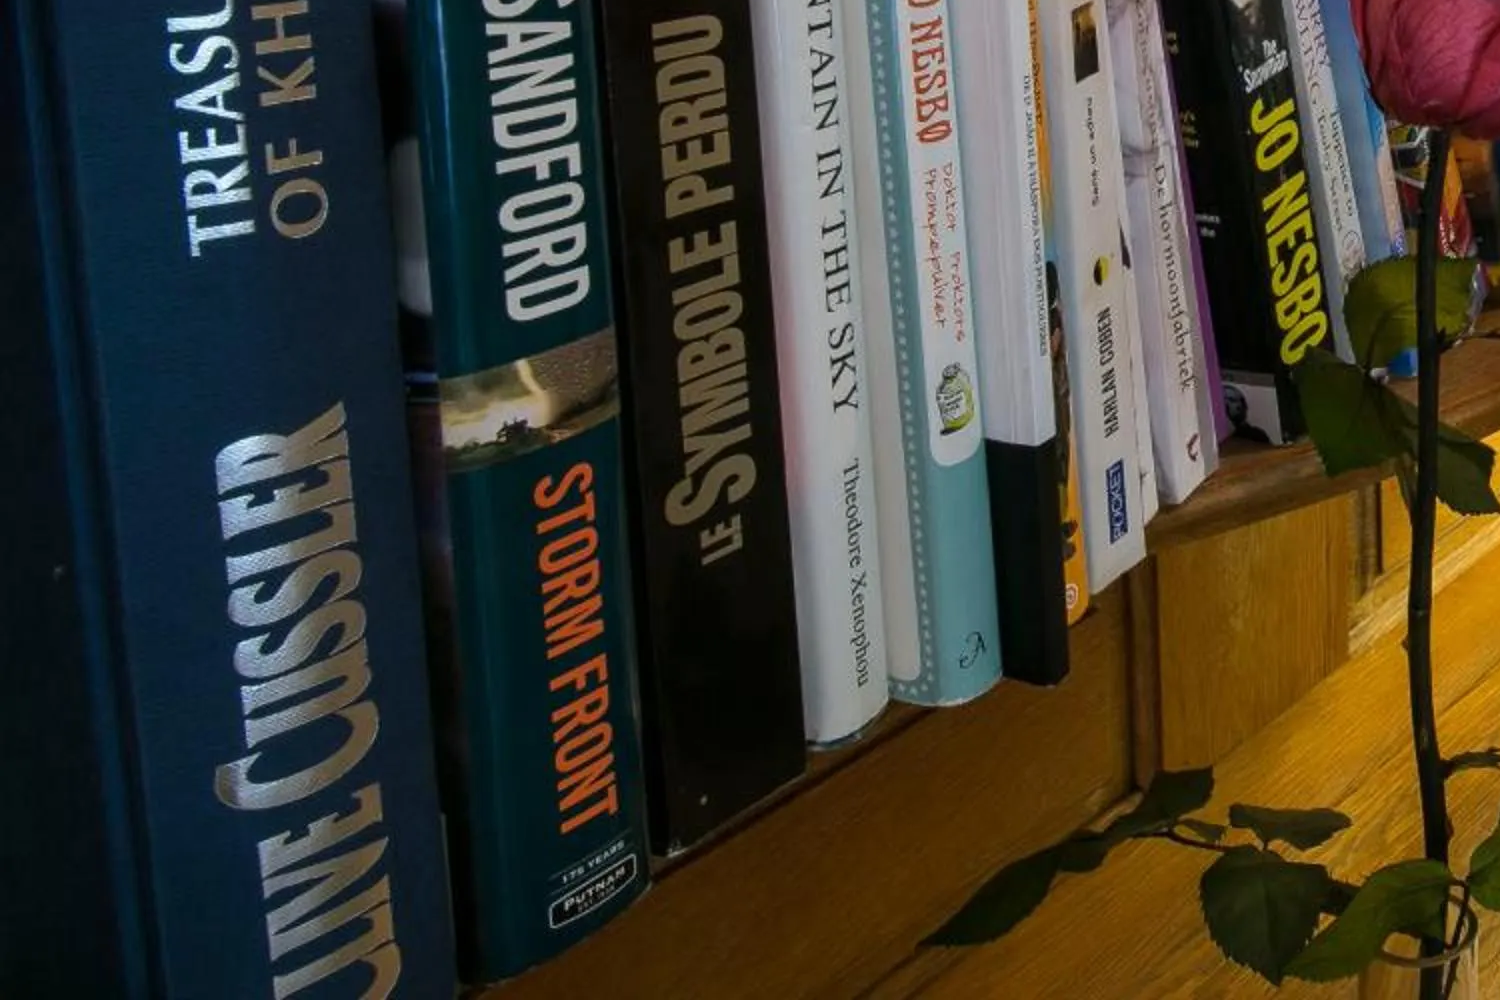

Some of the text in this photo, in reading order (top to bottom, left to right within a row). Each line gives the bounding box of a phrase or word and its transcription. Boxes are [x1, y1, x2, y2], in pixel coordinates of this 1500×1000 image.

[265, 137, 328, 239] OF
[816, 147, 845, 200] IN
[1250, 98, 1299, 172] JO
[652, 14, 757, 566] LE SYMBOLE PERDU
[821, 208, 852, 314] THE
[1154, 164, 1199, 393] De hormoonfabriek
[828, 321, 859, 413] SKY
[1097, 306, 1119, 438] HARLAN COBEN
[843, 457, 863, 569] Theodore
[1108, 462, 1127, 542] POCKET
[214, 401, 380, 811] CUSSLER
[533, 462, 604, 660] STORM
[549, 652, 619, 835] FRONT
[563, 865, 626, 911] PUTNAM
